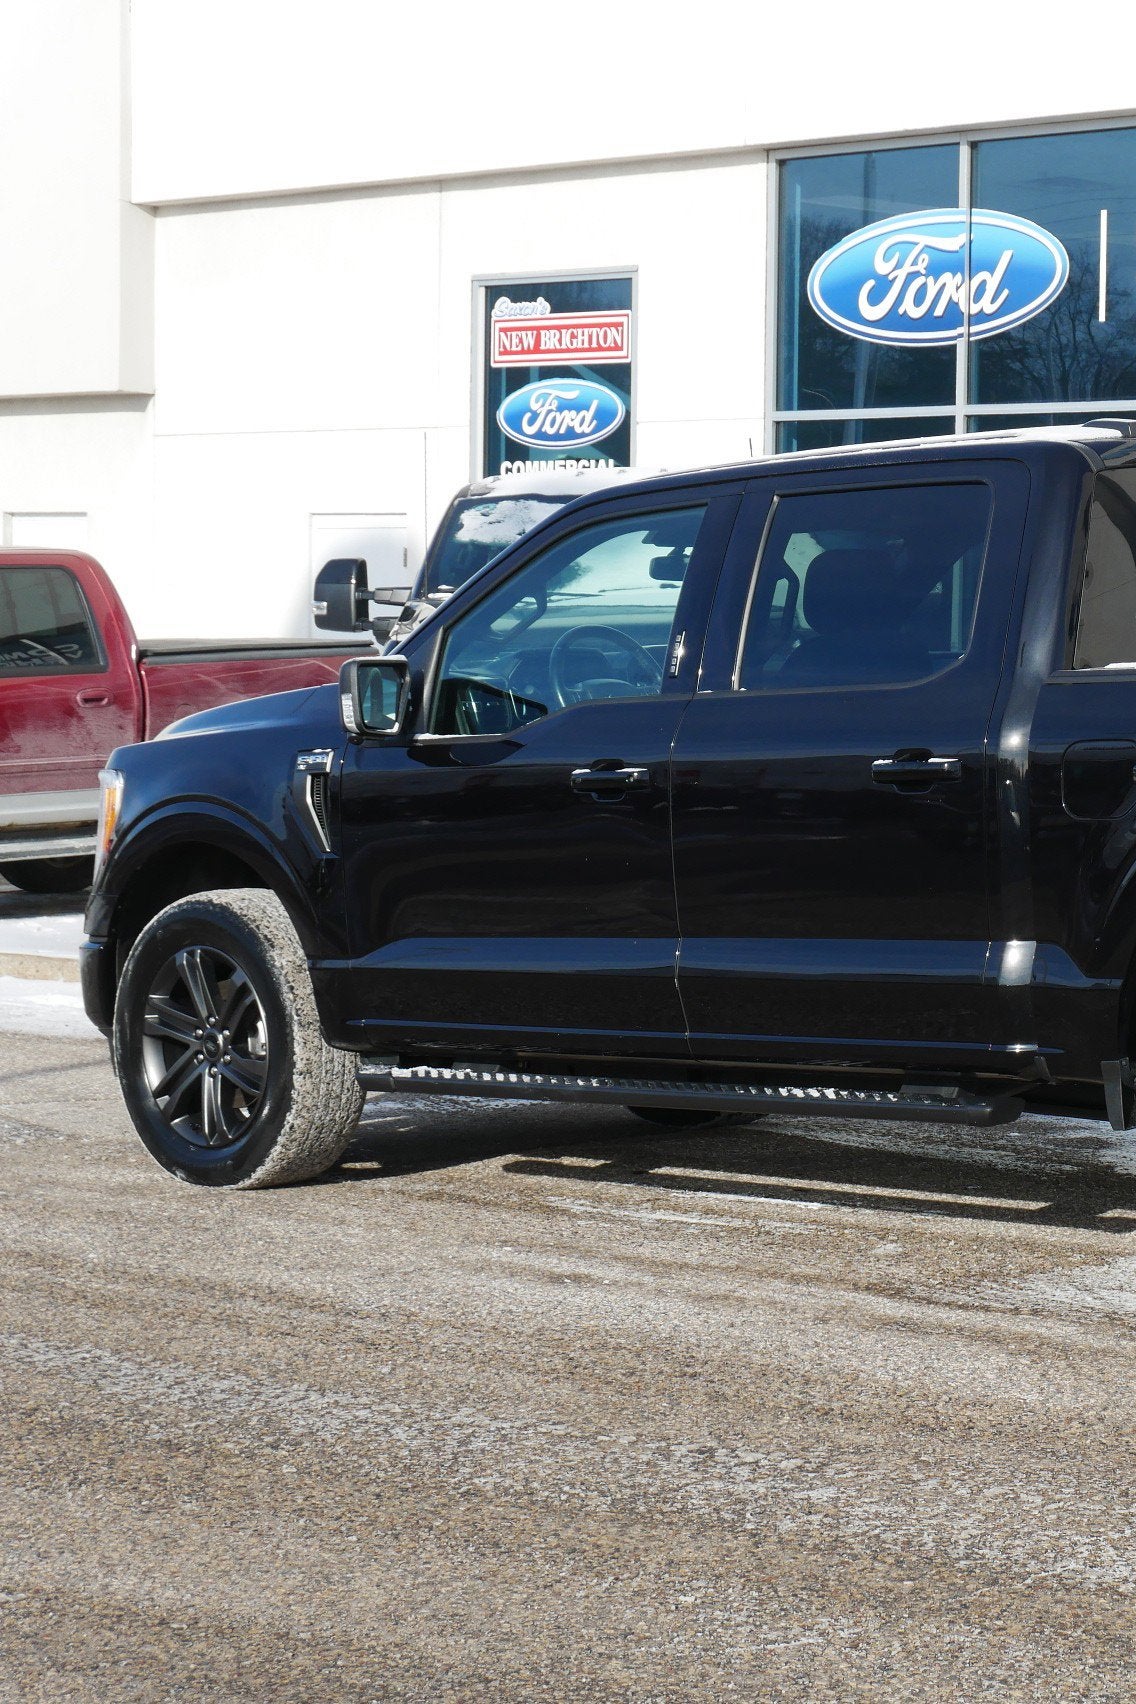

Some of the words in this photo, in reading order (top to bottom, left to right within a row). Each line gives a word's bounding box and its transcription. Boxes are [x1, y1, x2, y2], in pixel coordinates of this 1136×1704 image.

[858, 232, 1014, 322] Ford
[499, 330, 537, 352] NEW
[539, 326, 623, 350] BRIGHTON
[521, 388, 598, 436] Ford
